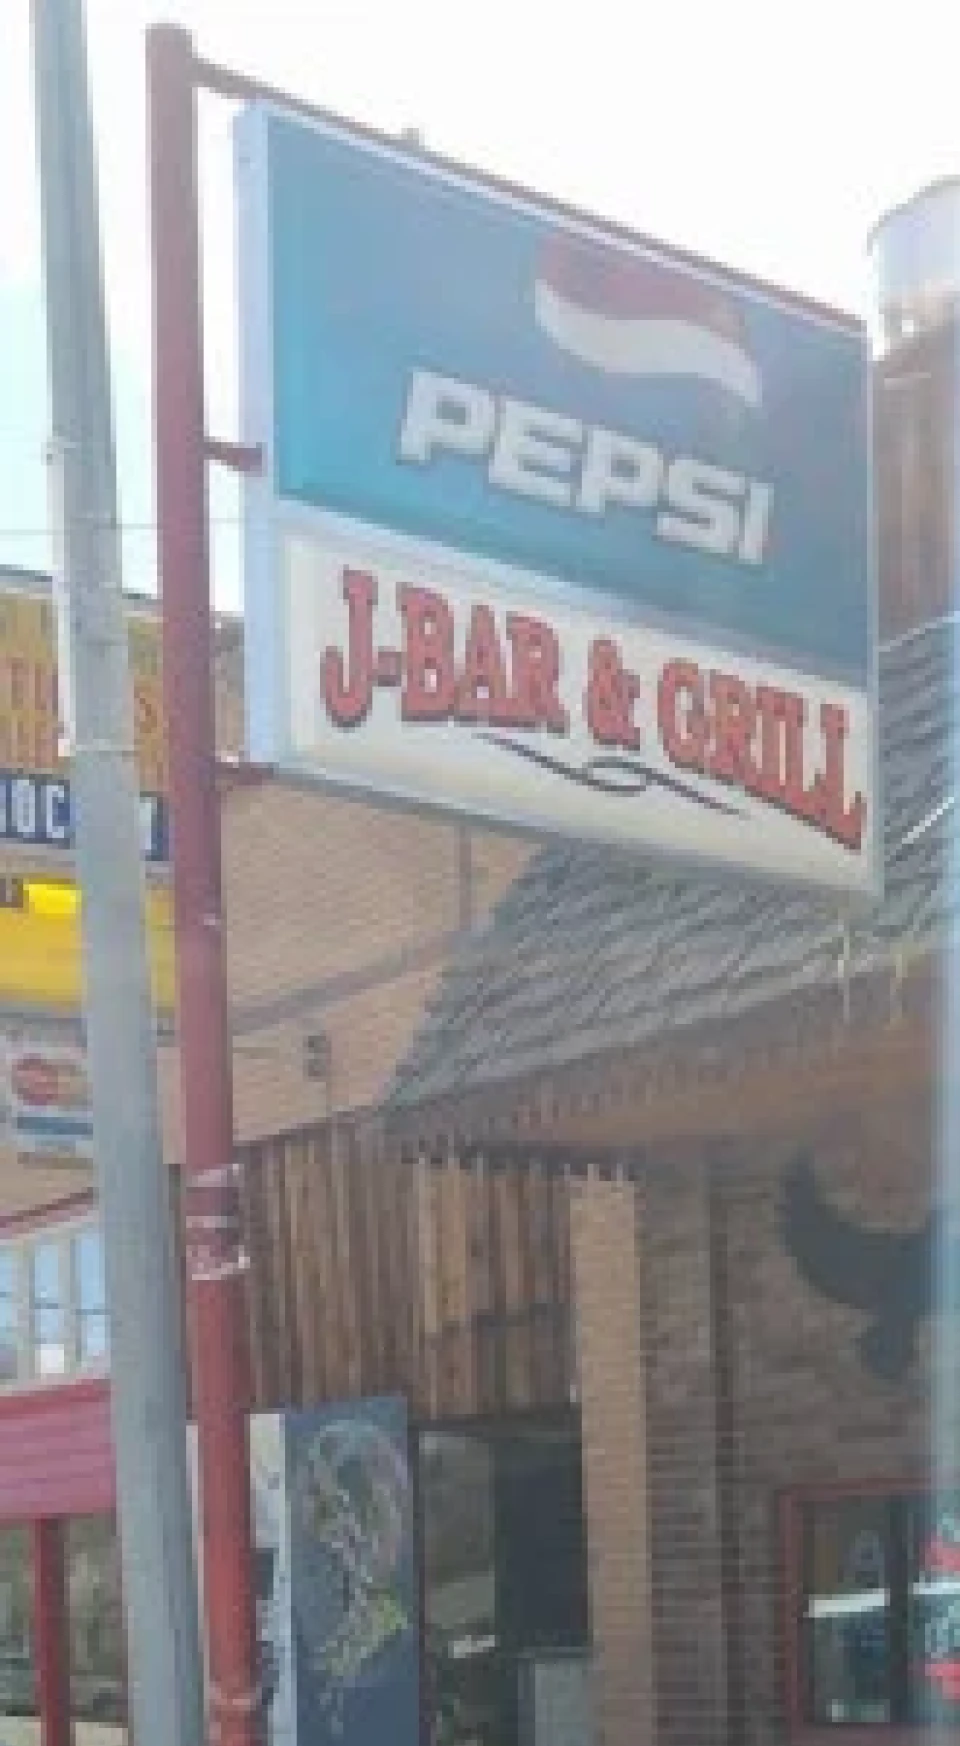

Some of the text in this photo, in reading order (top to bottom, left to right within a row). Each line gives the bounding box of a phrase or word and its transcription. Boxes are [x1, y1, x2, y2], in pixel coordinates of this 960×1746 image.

[395, 369, 775, 566] PEPSI
[319, 566, 865, 852] J-BAR & GRILL
